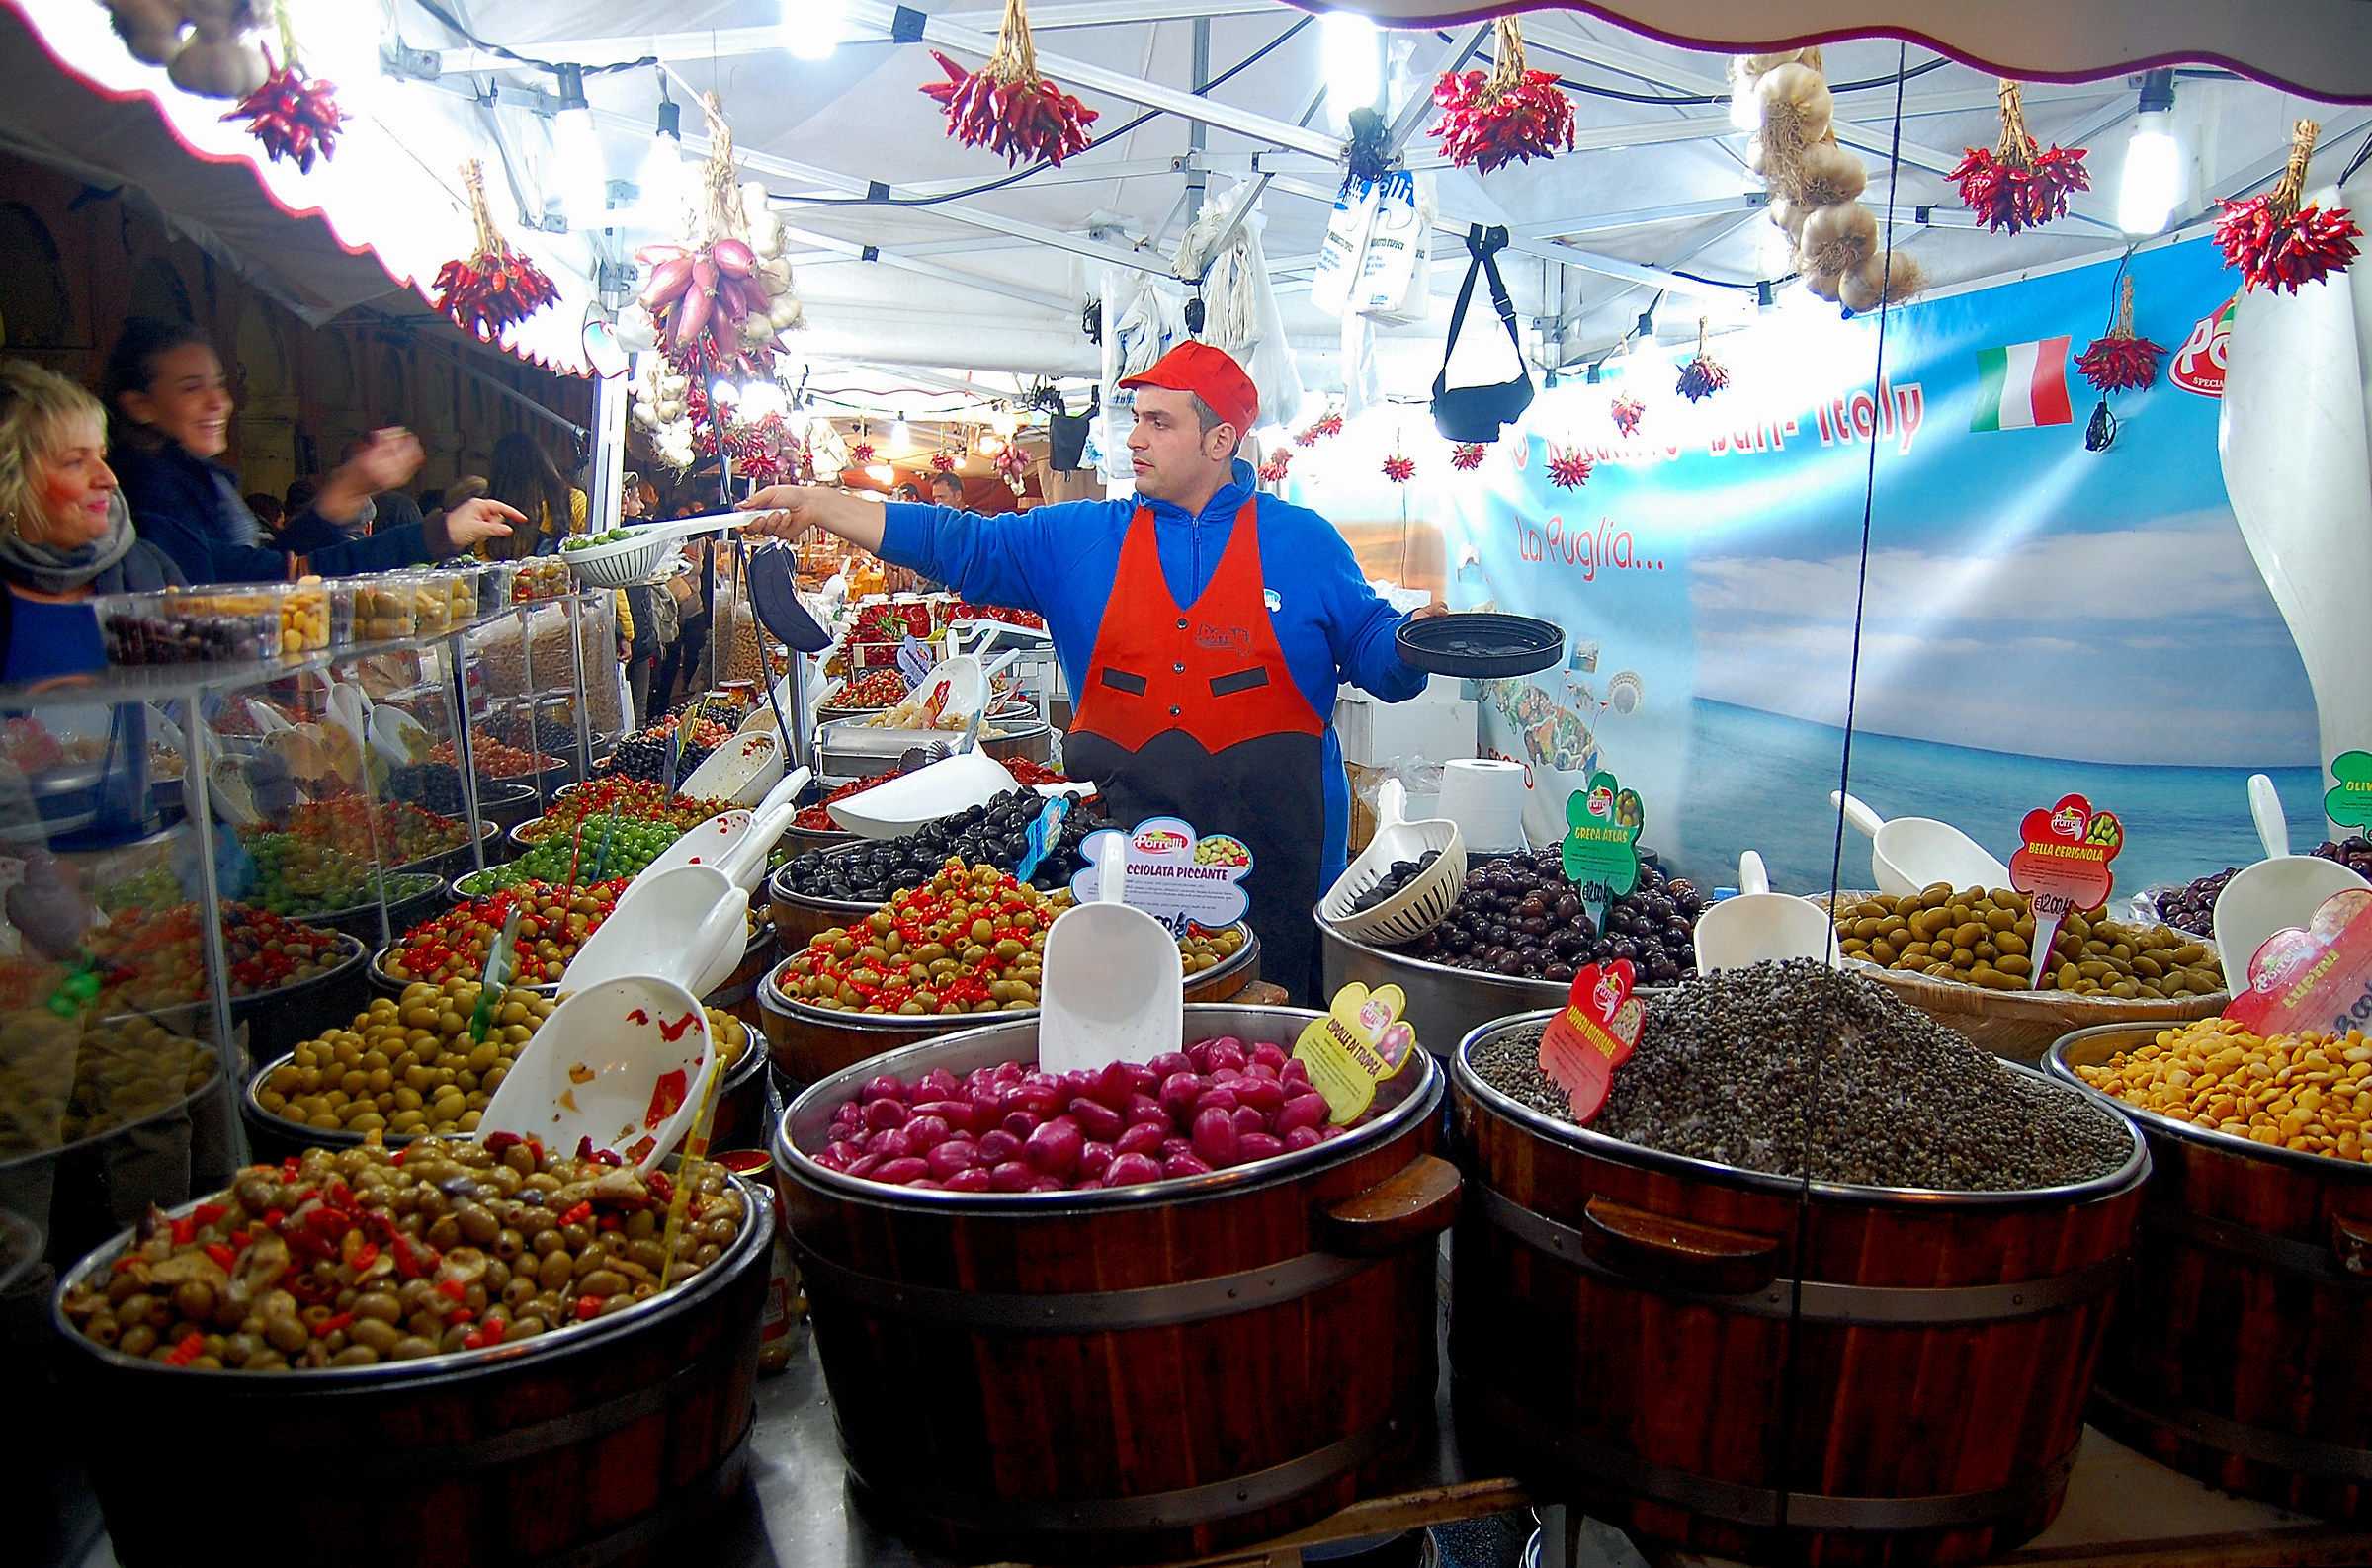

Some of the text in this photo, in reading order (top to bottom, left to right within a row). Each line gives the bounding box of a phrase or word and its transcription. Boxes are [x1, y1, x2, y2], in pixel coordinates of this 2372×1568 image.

[1817, 373, 1924, 454] Italy
[1134, 834, 1184, 849] Porrelli
[1575, 826, 1628, 843] GRECA ATLAS
[2028, 841, 2104, 863] BELLA CERIGNOLA
[1177, 867, 1228, 881] PICCANTE
[2282, 949, 2341, 1009] LUPINI
[1346, 1040, 1357, 1055] DI
[1354, 1045, 1383, 1078] TROPEA
